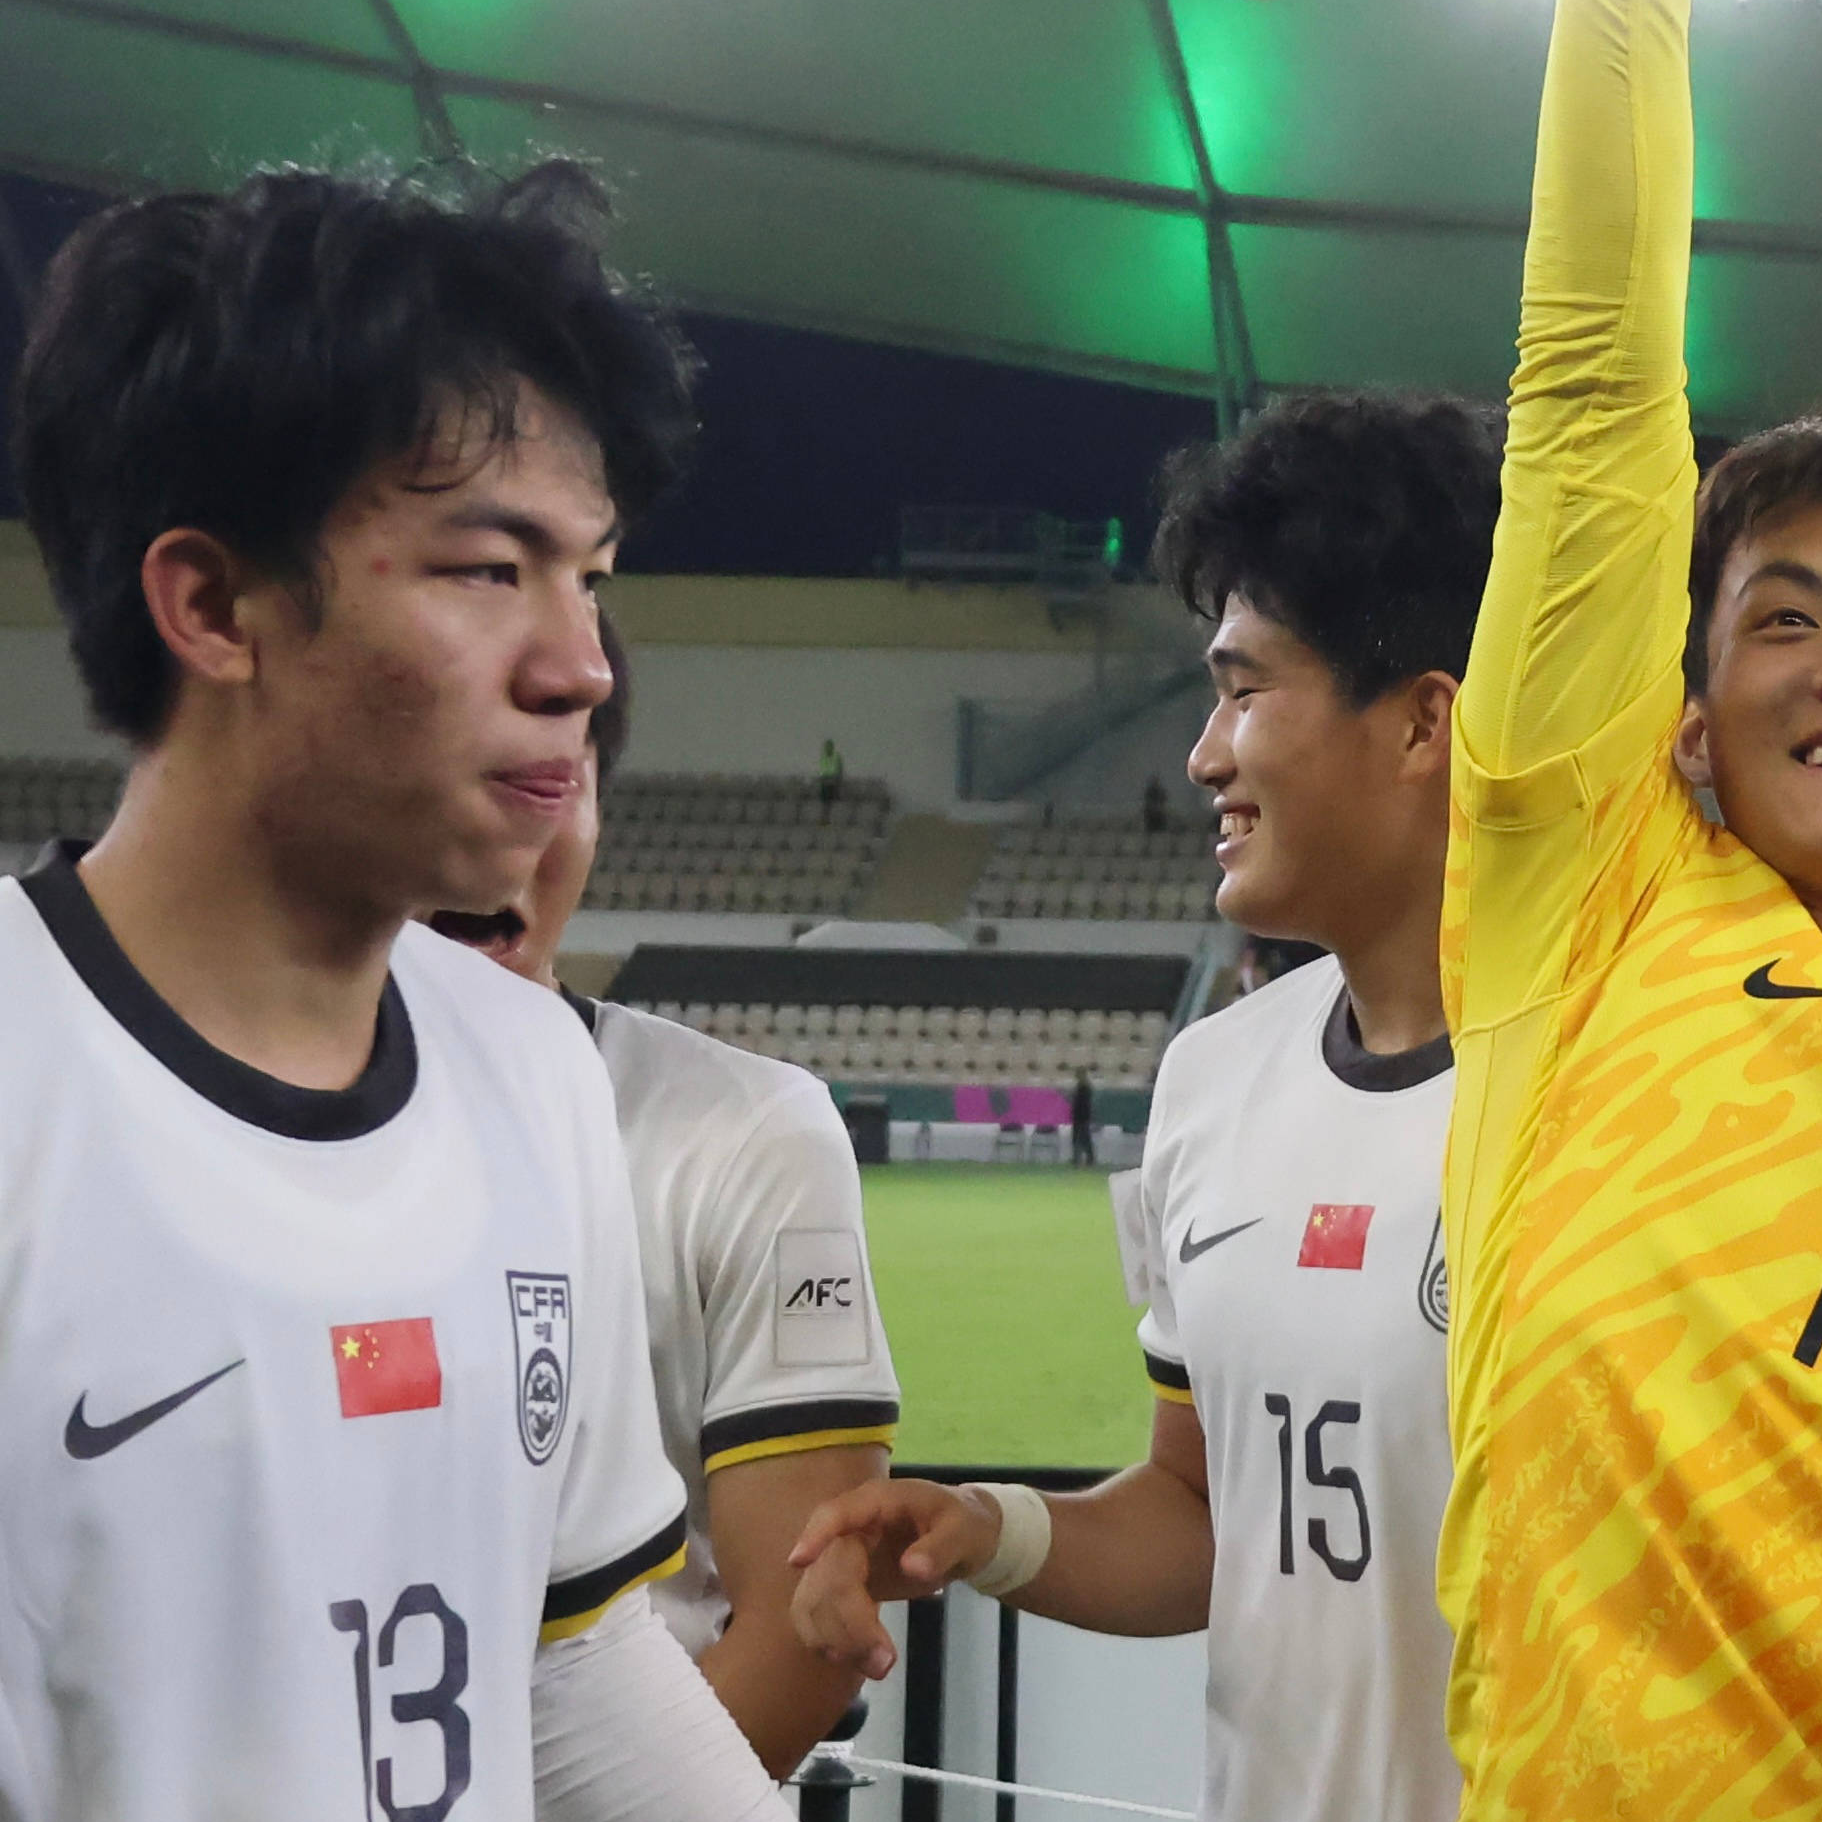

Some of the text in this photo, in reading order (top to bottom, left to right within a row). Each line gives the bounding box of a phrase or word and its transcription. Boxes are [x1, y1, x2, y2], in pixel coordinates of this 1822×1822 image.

[515, 1284, 566, 1320] CFA
[785, 1277, 852, 1308] AFC
[1265, 1393, 1371, 1582] 15
